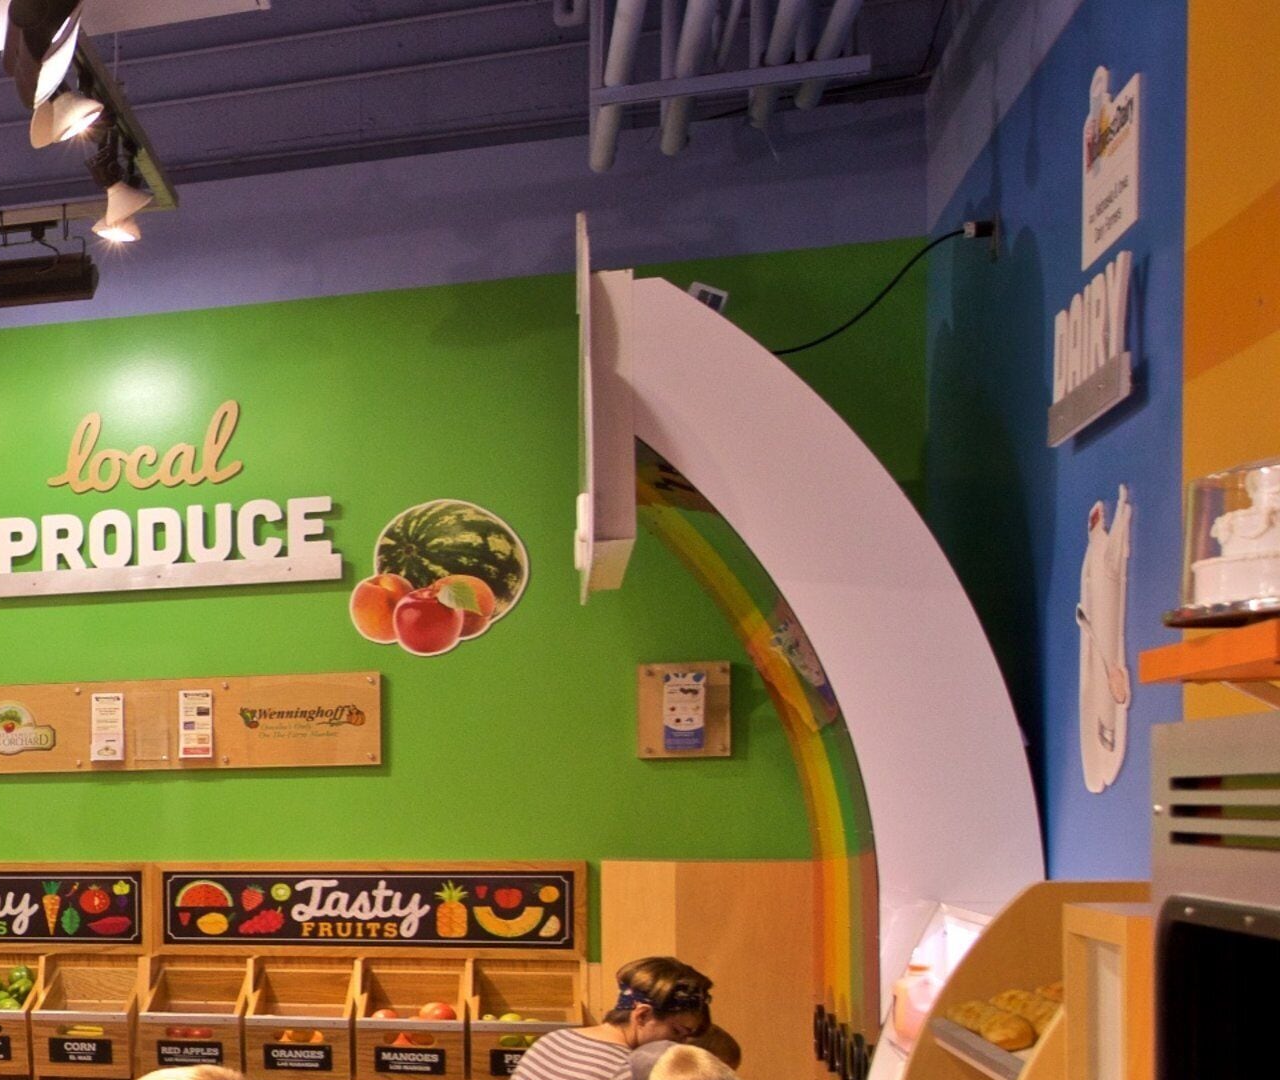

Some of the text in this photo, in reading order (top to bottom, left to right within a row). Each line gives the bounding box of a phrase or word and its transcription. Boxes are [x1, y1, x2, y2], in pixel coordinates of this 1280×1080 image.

[1053, 251, 1133, 405] DAIRY
[46, 400, 243, 494] local
[291, 879, 431, 938] Tasty
[301, 922, 398, 937] FRUITS
[63, 1042, 97, 1052] CORN
[160, 1046, 220, 1057] RED APPLES
[270, 1049, 325, 1060] ORANGES
[381, 1052, 439, 1063] MANGOES
